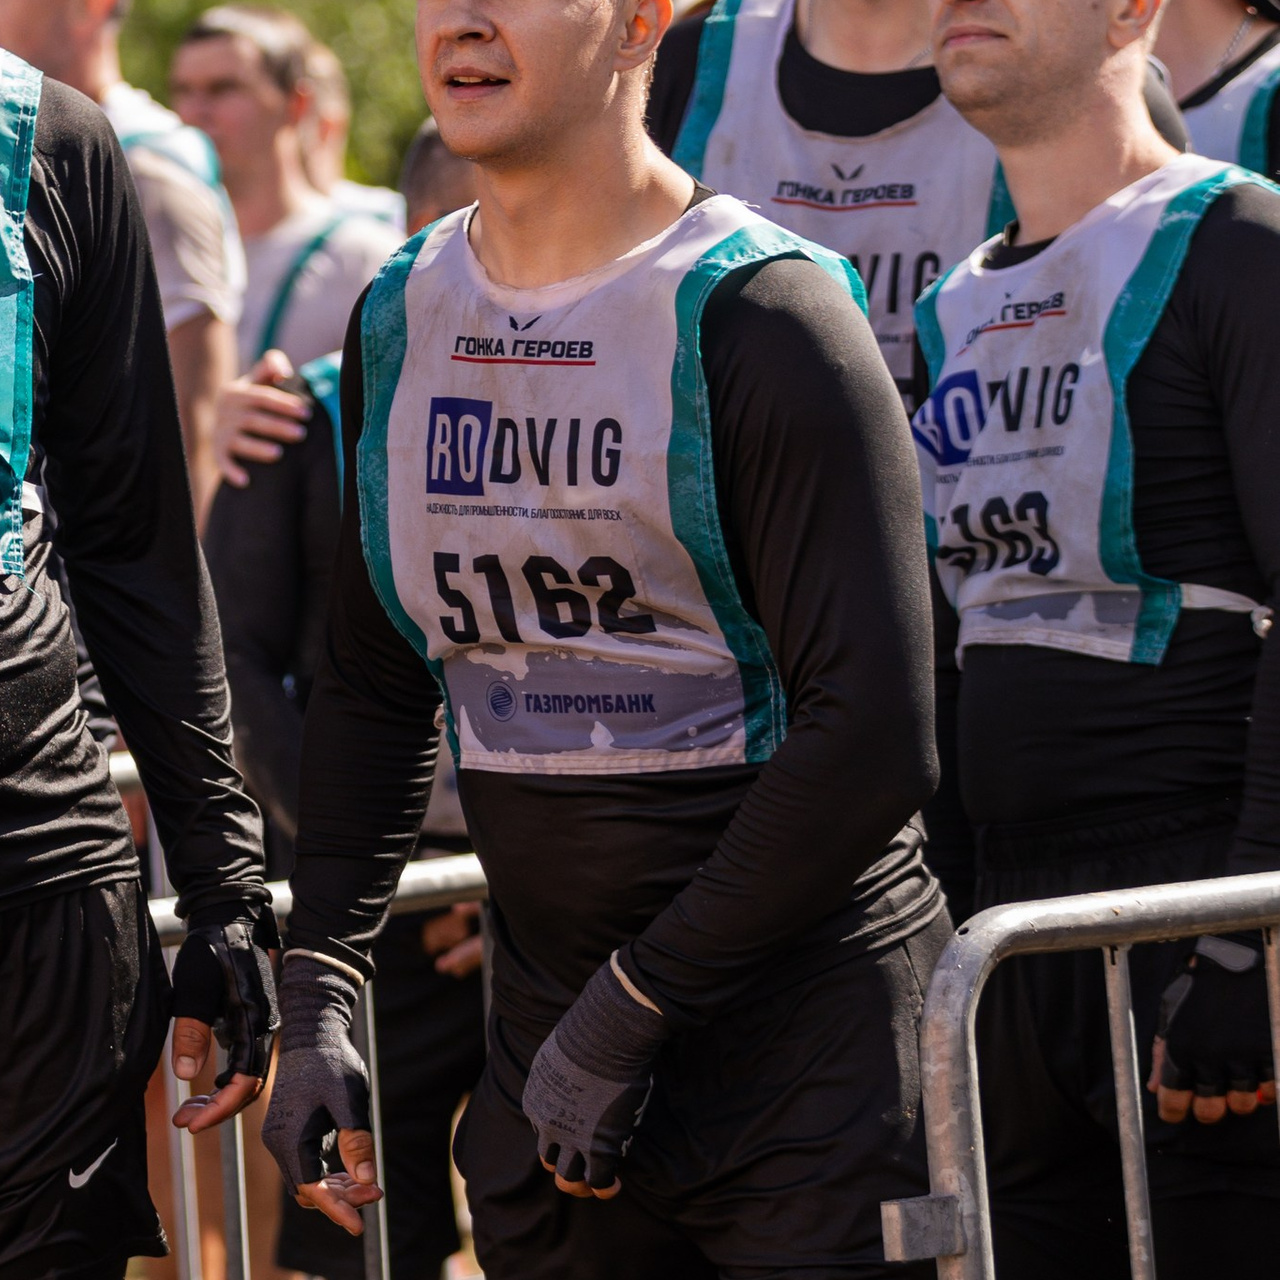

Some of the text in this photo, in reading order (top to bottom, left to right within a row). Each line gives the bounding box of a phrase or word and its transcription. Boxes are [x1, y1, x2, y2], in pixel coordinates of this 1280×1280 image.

[841, 182, 915, 205] ГЕРОЕВ
[455, 335, 593, 359] ГОНКА ГЕРОЕВ
[431, 413, 623, 486] RODVIG
[602, 509, 622, 521] ВСЕХ
[434, 552, 657, 644] 5162
[525, 693, 656, 715] ГАЗПРОМБАНК
